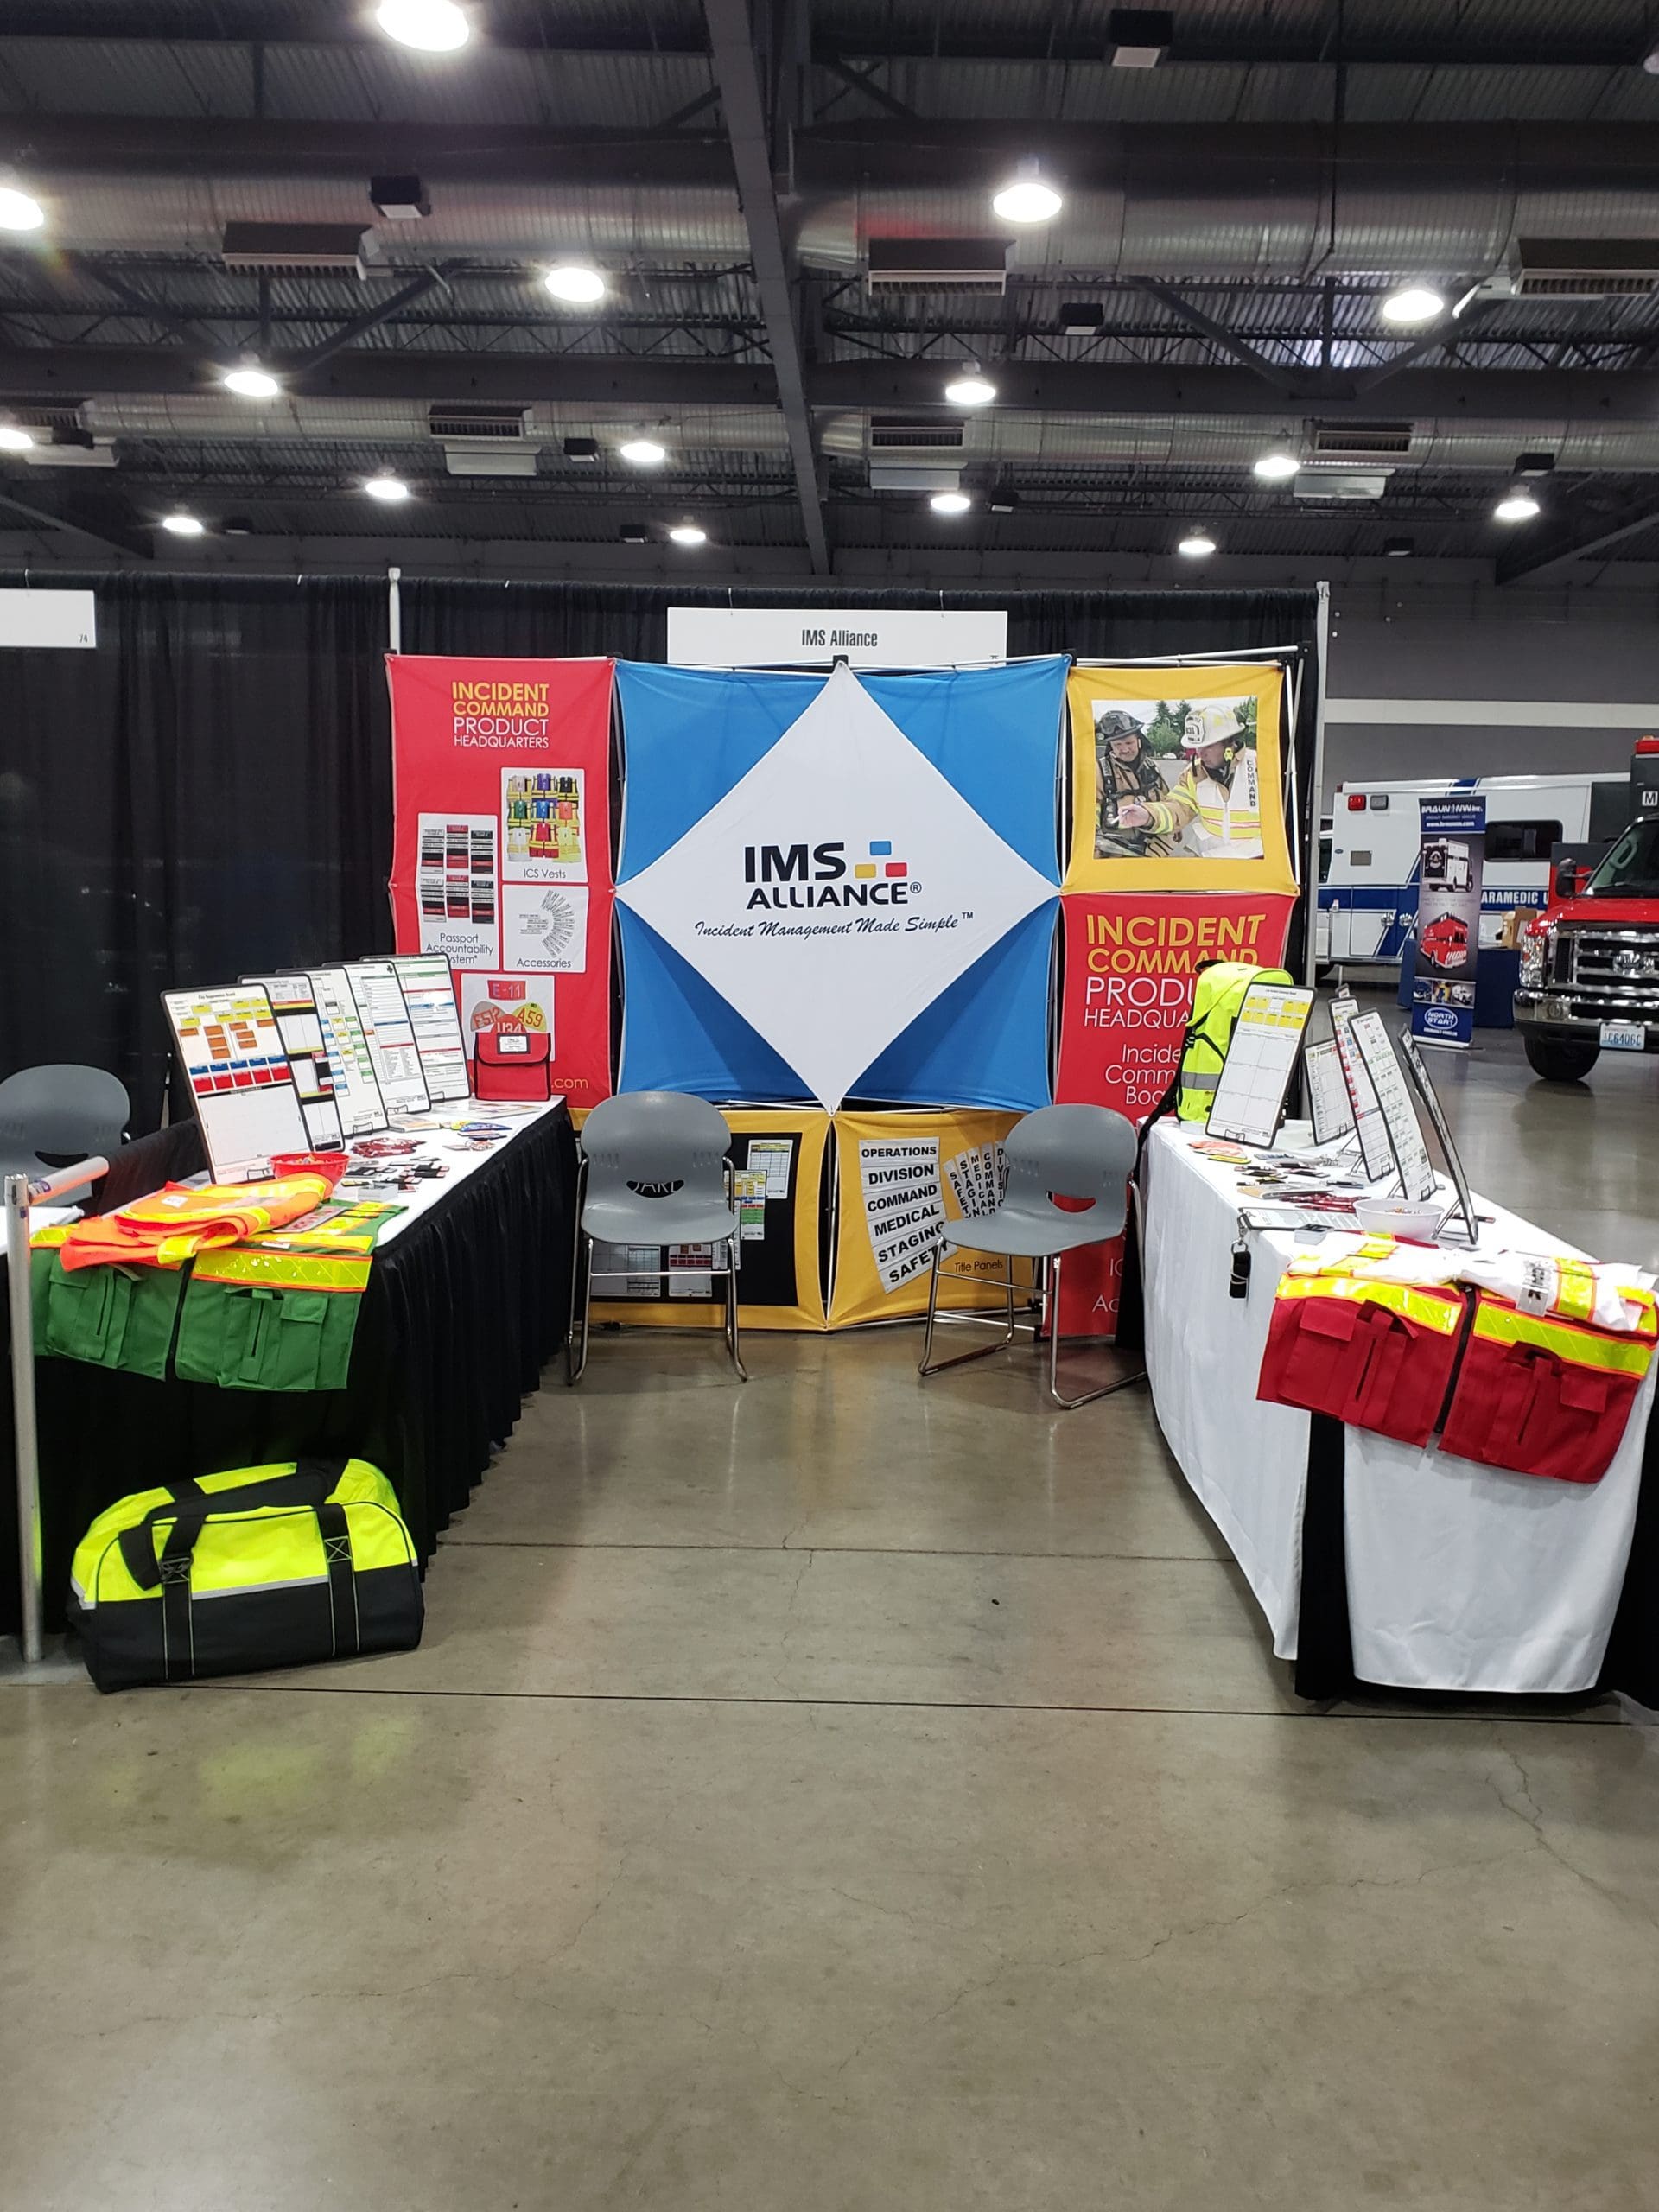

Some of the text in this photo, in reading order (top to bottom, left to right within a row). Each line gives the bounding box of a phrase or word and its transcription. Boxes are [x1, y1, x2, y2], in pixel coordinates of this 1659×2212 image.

[802, 629, 878, 647] IMS Alliance
[452, 681, 550, 702] INCIDENT
[453, 701, 550, 717] COMMAND
[454, 716, 549, 736] PRODUCT
[454, 734, 549, 749] HEADQUARTERS
[744, 842, 847, 883] IMS
[523, 868, 567, 880] ICS Vests
[440, 932, 479, 944] Passport
[694, 920, 754, 938] Incident
[758, 920, 852, 940] Management
[854, 918, 900, 933] Made
[1086, 913, 1267, 947] INCIDENT
[426, 944, 494, 956] Accountability
[516, 957, 571, 969] Accessories
[518, 1007, 543, 1027] A59
[861, 1146, 937, 1158] OPERATIONS
[868, 1164, 935, 1185] DIVISION
[867, 1184, 938, 1212] COMMAND
[874, 1205, 940, 1236] MEDICAL
[954, 1259, 1003, 1272] Title Panels
